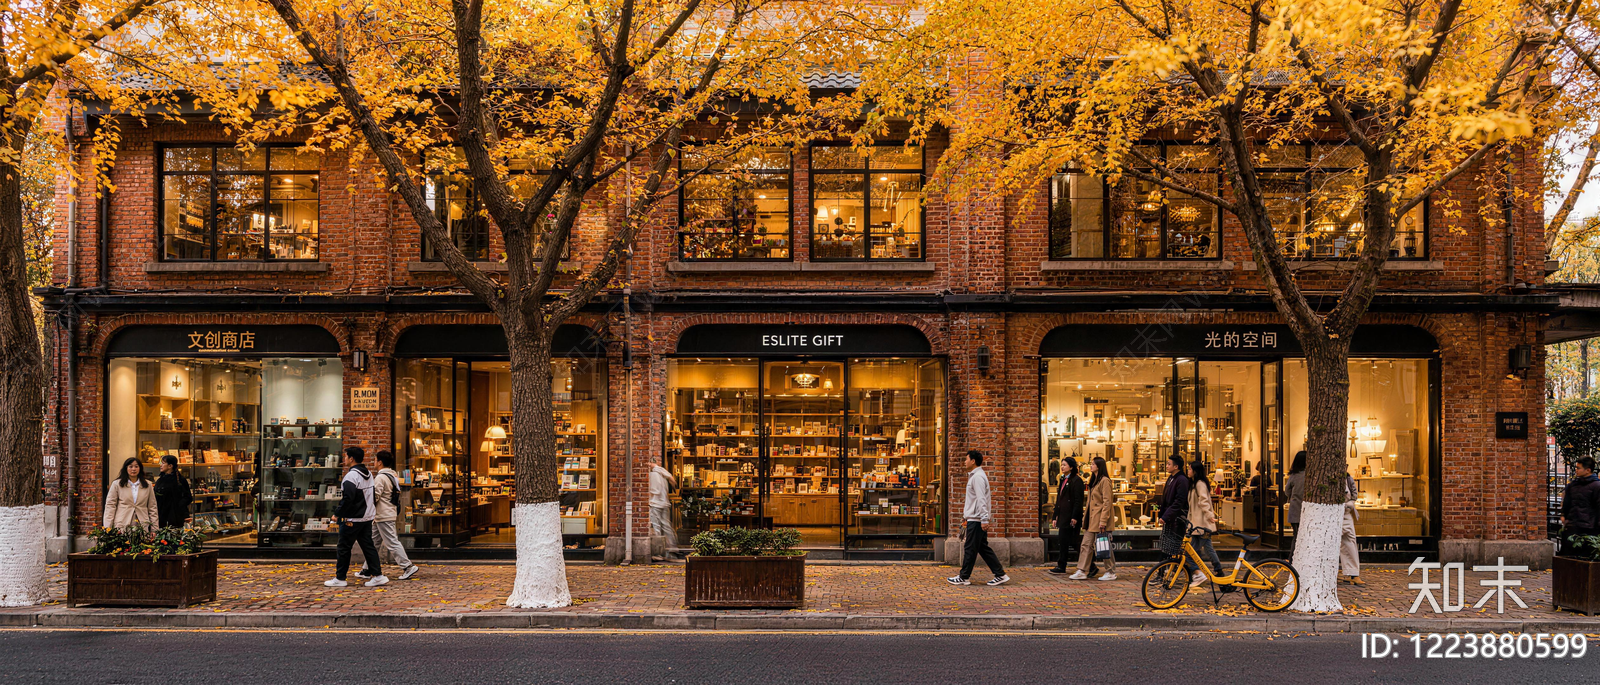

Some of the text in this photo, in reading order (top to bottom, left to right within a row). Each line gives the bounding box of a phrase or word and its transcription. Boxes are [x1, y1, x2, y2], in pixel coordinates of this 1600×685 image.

[187, 330, 256, 349] 文创商店
[762, 334, 844, 347] ESLITE GIFT
[1204, 331, 1277, 348] 光的空间
